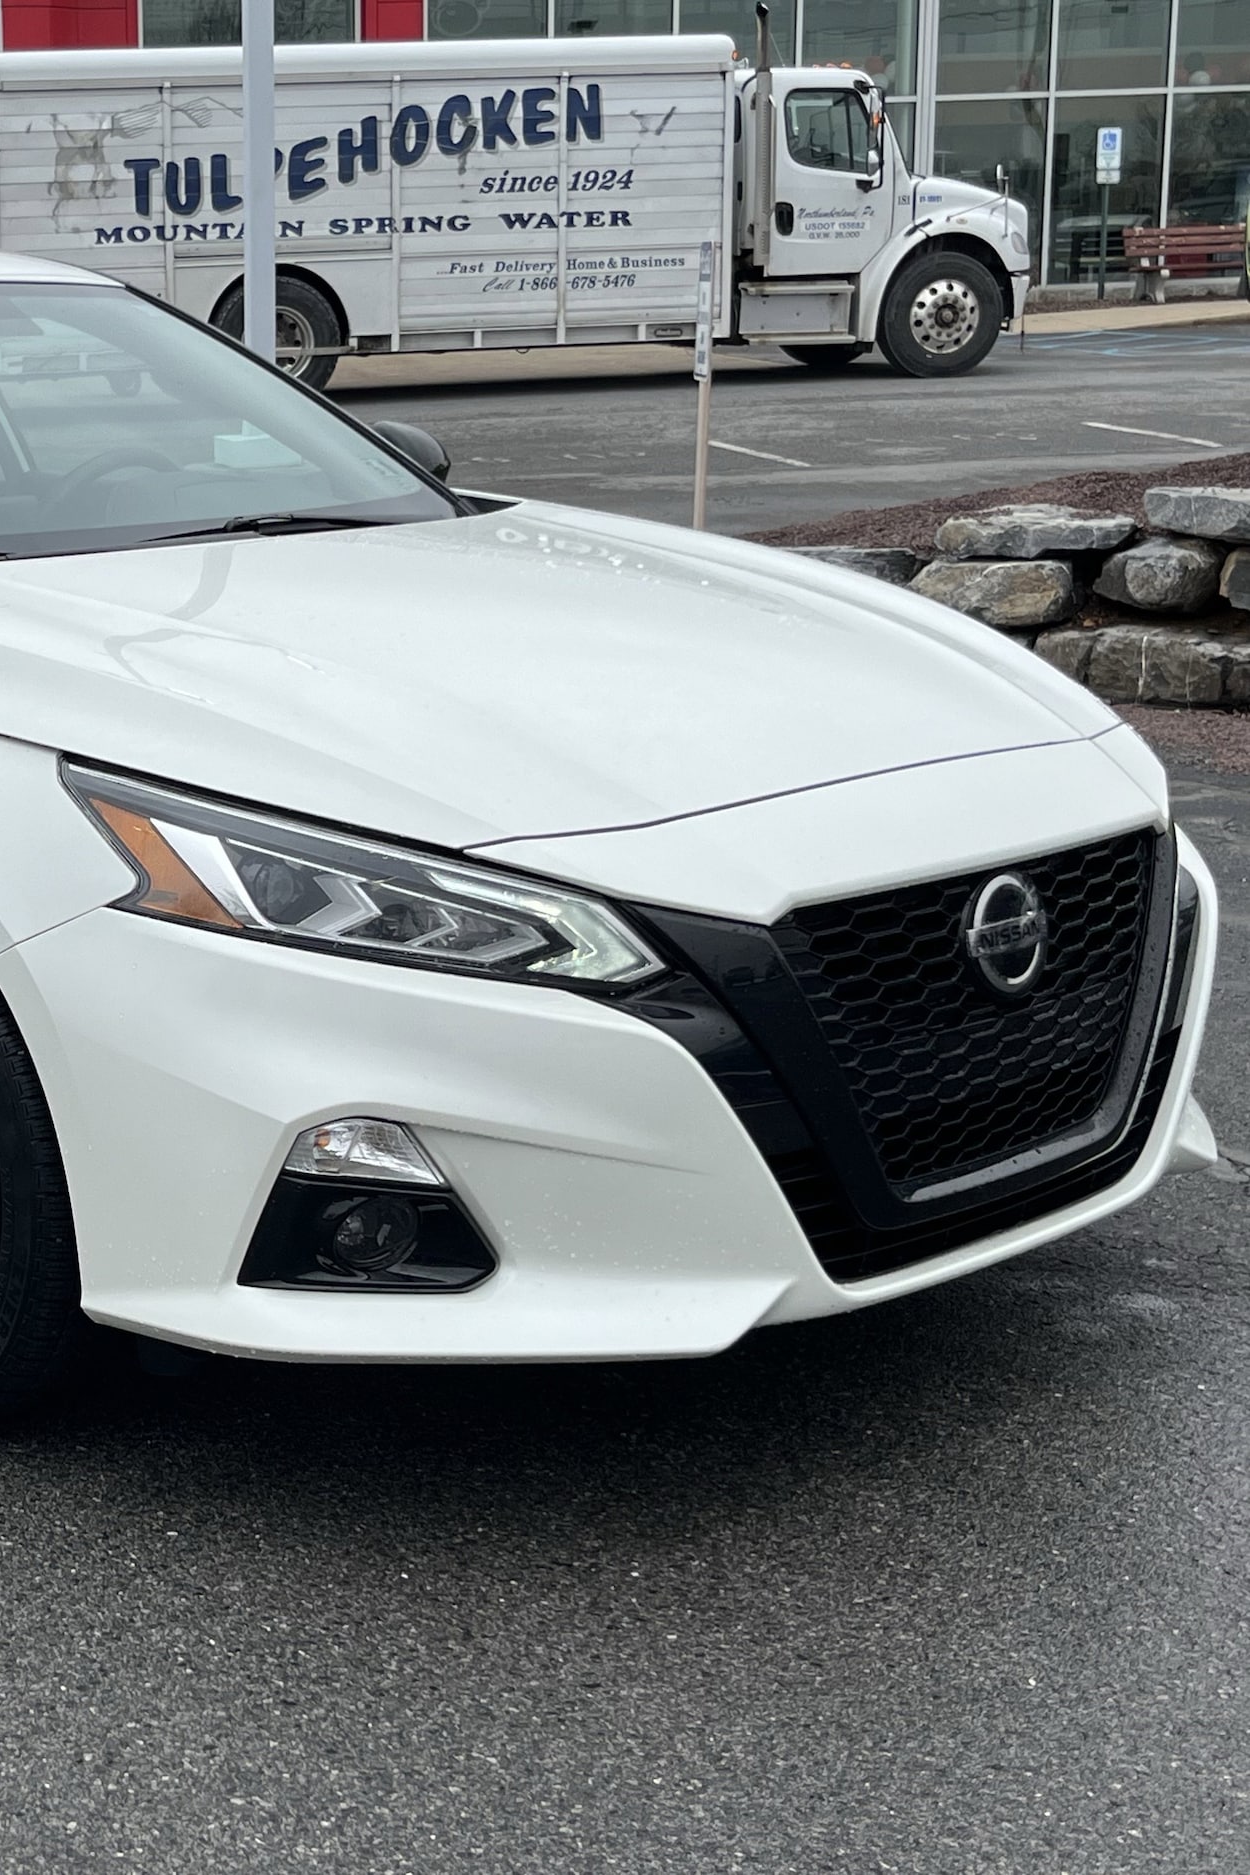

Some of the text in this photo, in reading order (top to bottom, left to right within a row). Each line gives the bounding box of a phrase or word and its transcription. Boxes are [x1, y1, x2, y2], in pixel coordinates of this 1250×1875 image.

[124, 84, 602, 217] TULEHOCKEN
[479, 169, 634, 194] since 1924
[94, 209, 632, 244] MOUNTN SPRING WATER
[804, 222, 836, 231] USDOT
[493, 260, 557, 275] Delivery
[566, 258, 605, 271] Home
[606, 257, 618, 269] &
[621, 256, 686, 269] Business
[980, 921, 1040, 947] NISSAN
